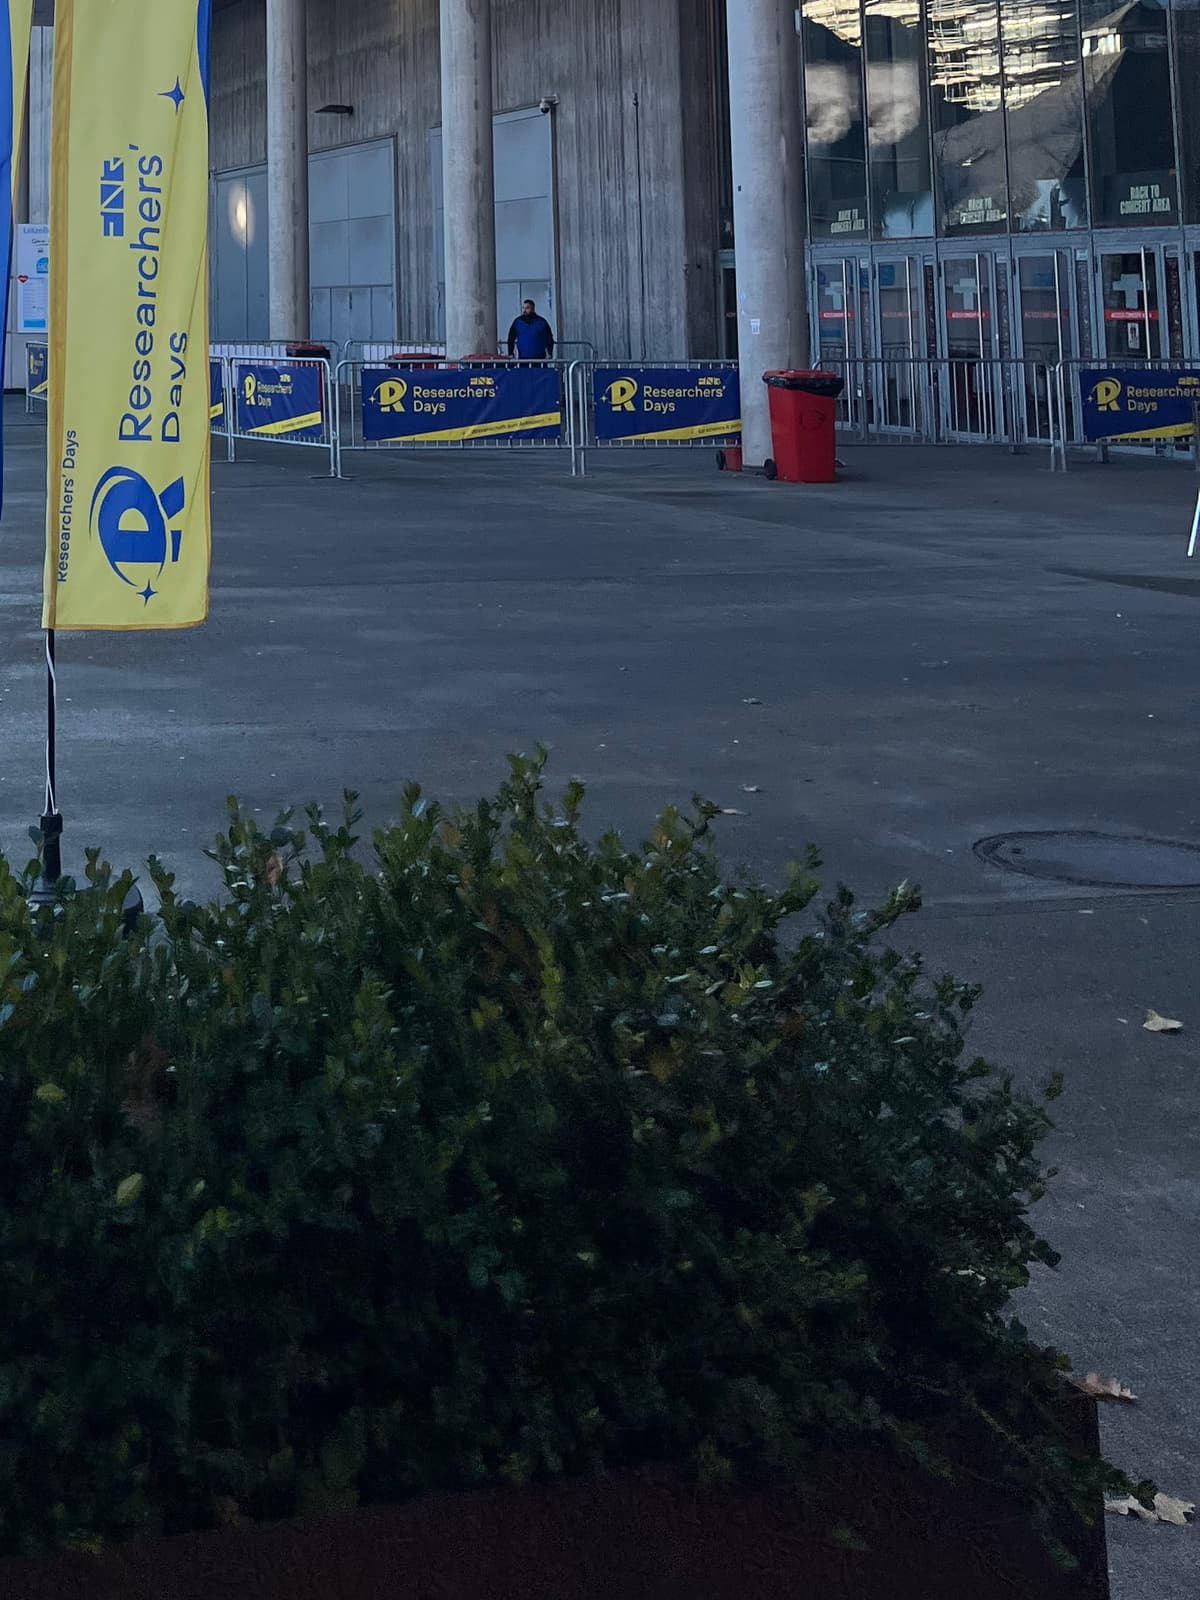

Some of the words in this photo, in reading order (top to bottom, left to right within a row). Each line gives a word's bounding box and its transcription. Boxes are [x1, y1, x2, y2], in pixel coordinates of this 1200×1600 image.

[1150, 184, 1160, 199] TO
[1120, 199, 1151, 215] CONCERT
[118, 144, 164, 442] Researchers'
[161, 331, 188, 443] Days
[413, 385, 499, 398] Researchers'
[643, 385, 726, 398] Researchers'
[413, 401, 446, 415] Days
[643, 399, 676, 414] Days
[1127, 399, 1158, 414] Days
[63, 429, 77, 472] Days
[57, 475, 75, 583] Researchers'
